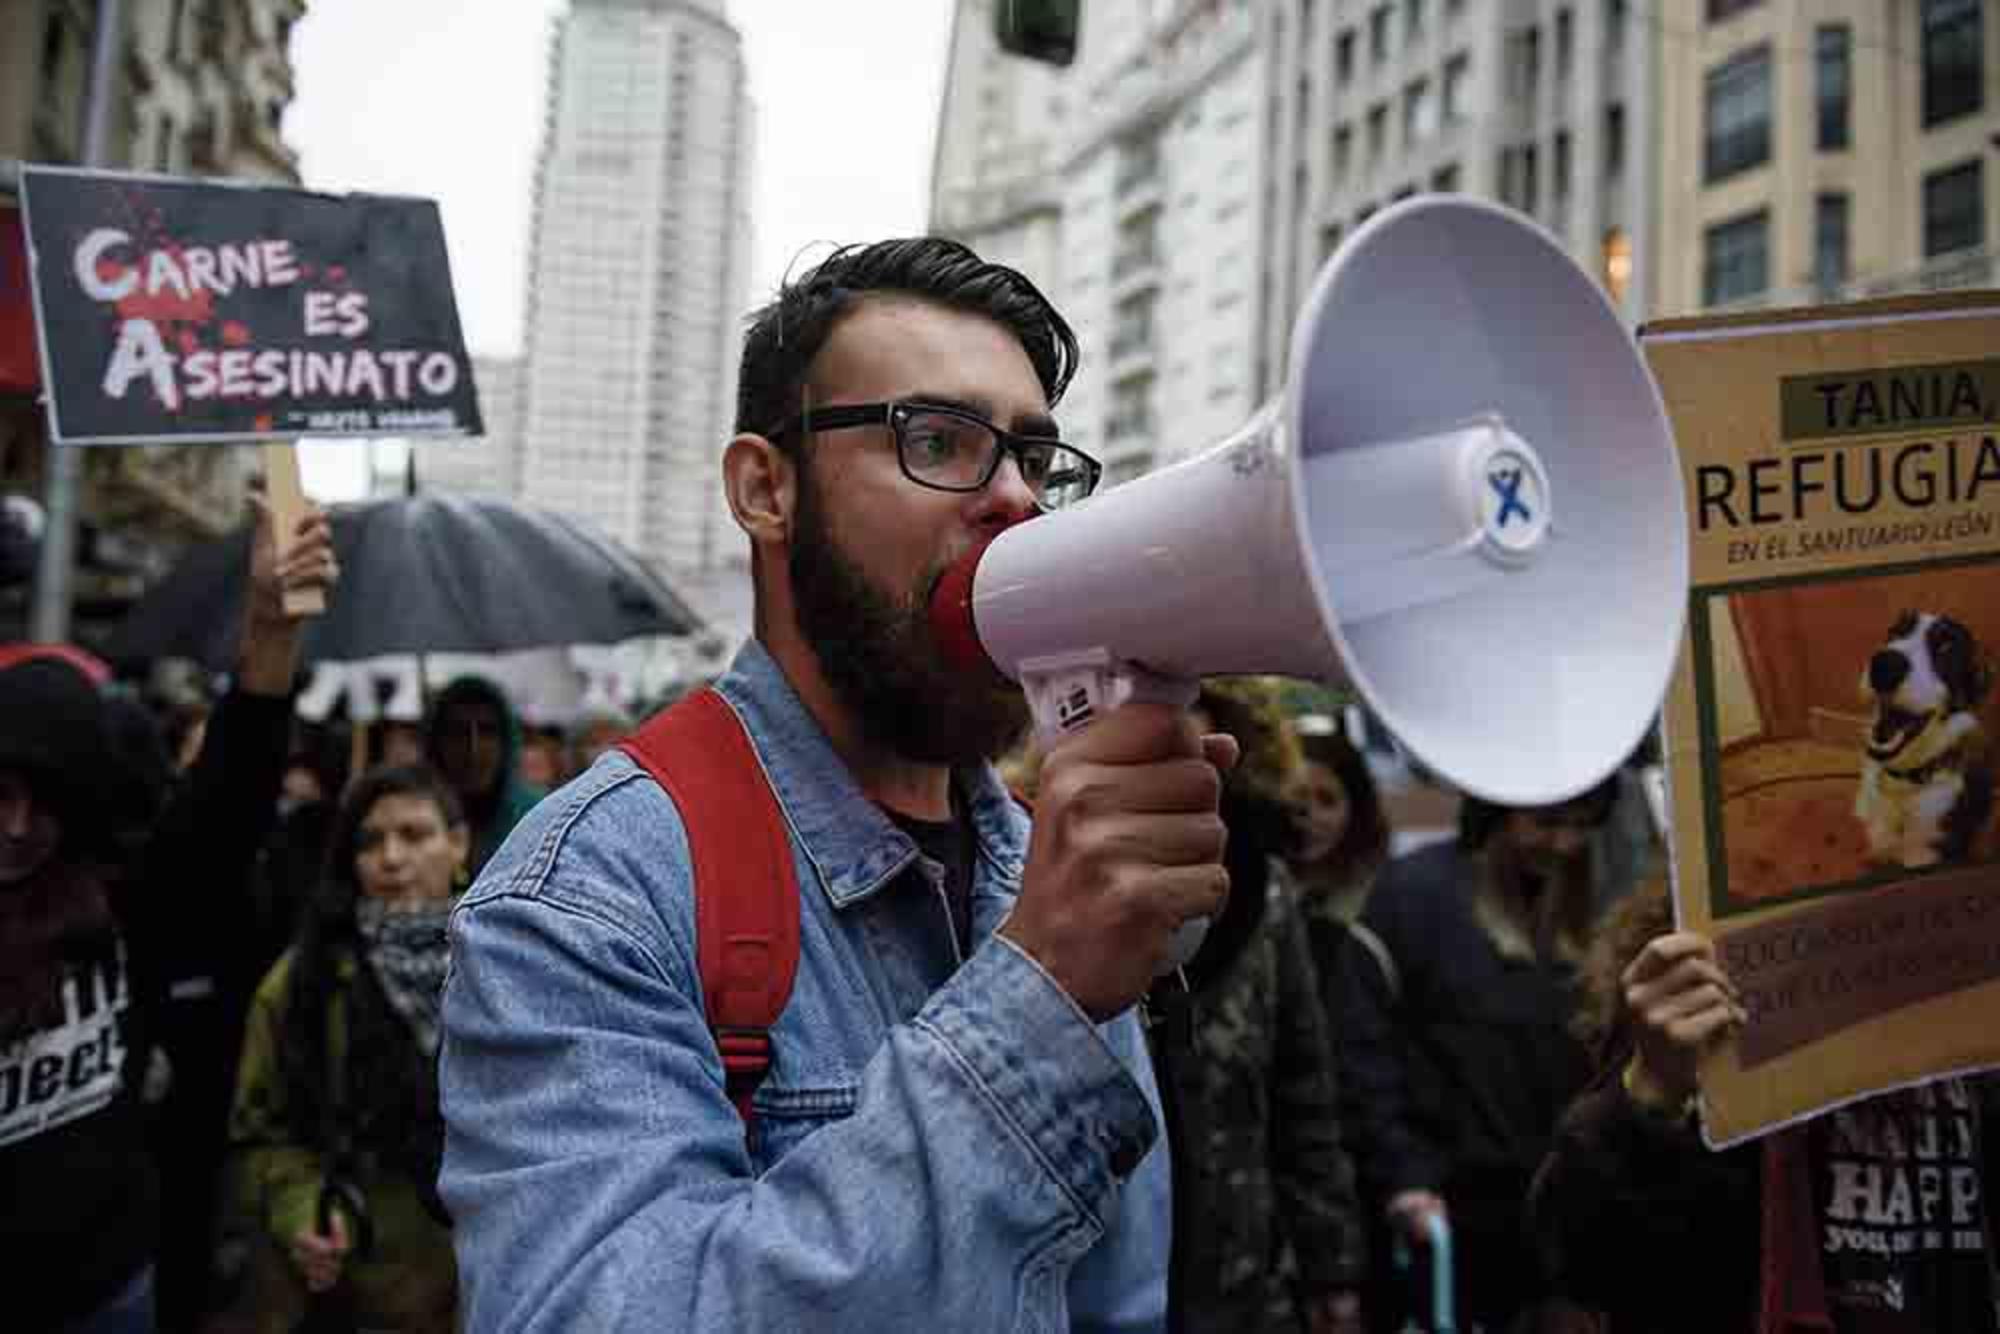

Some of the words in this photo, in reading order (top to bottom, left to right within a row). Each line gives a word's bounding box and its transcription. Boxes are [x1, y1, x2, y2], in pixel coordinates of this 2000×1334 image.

[73, 228, 299, 300] CARNE
[303, 290, 369, 337] ES
[102, 318, 457, 412] ASESINATO
